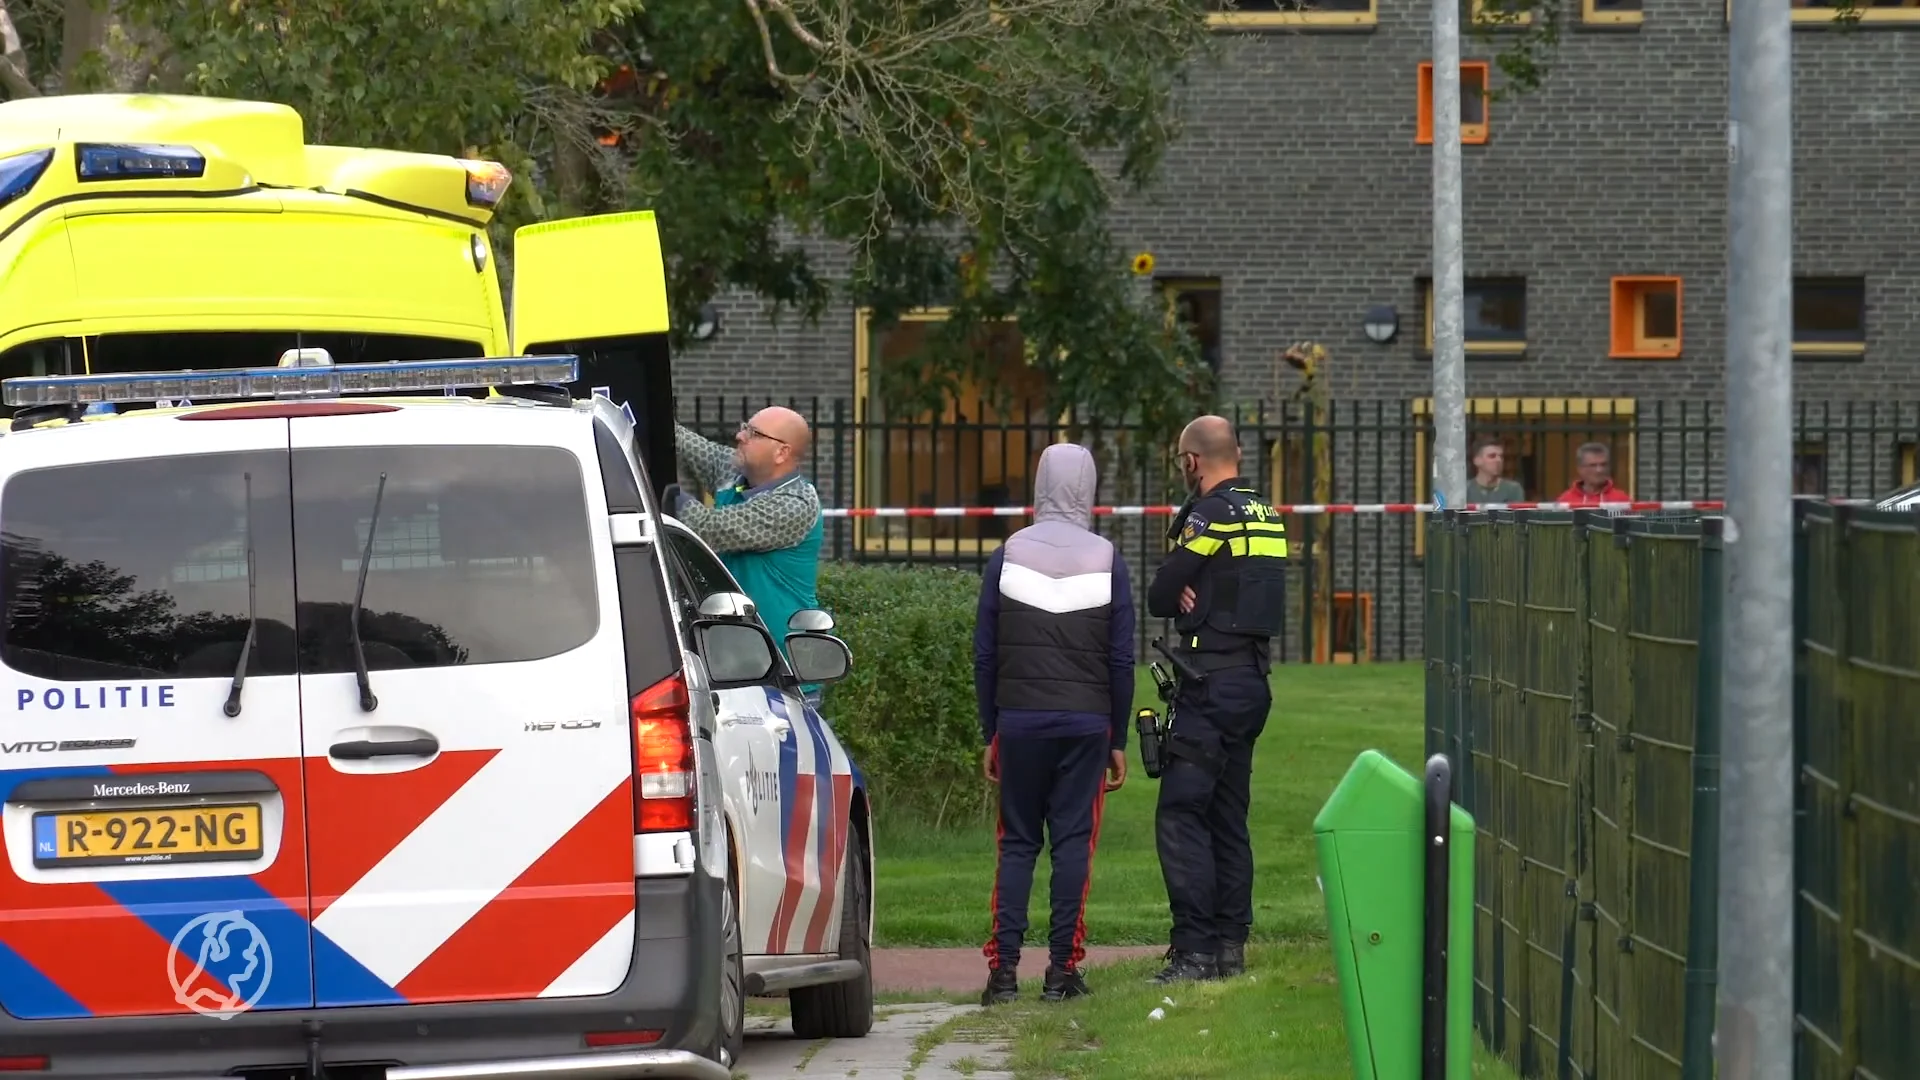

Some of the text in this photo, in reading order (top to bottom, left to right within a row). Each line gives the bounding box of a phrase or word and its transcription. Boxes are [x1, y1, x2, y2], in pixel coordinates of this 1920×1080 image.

[17, 685, 176, 711] POLITIE
[1, 739, 135, 754] VITO TOURER
[93, 781, 191, 797] Mercedes-Benz
[67, 813, 247, 853] R-922-NG
[39, 842, 55, 852] NL
[125, 854, 172, 863] www.politie.nl
